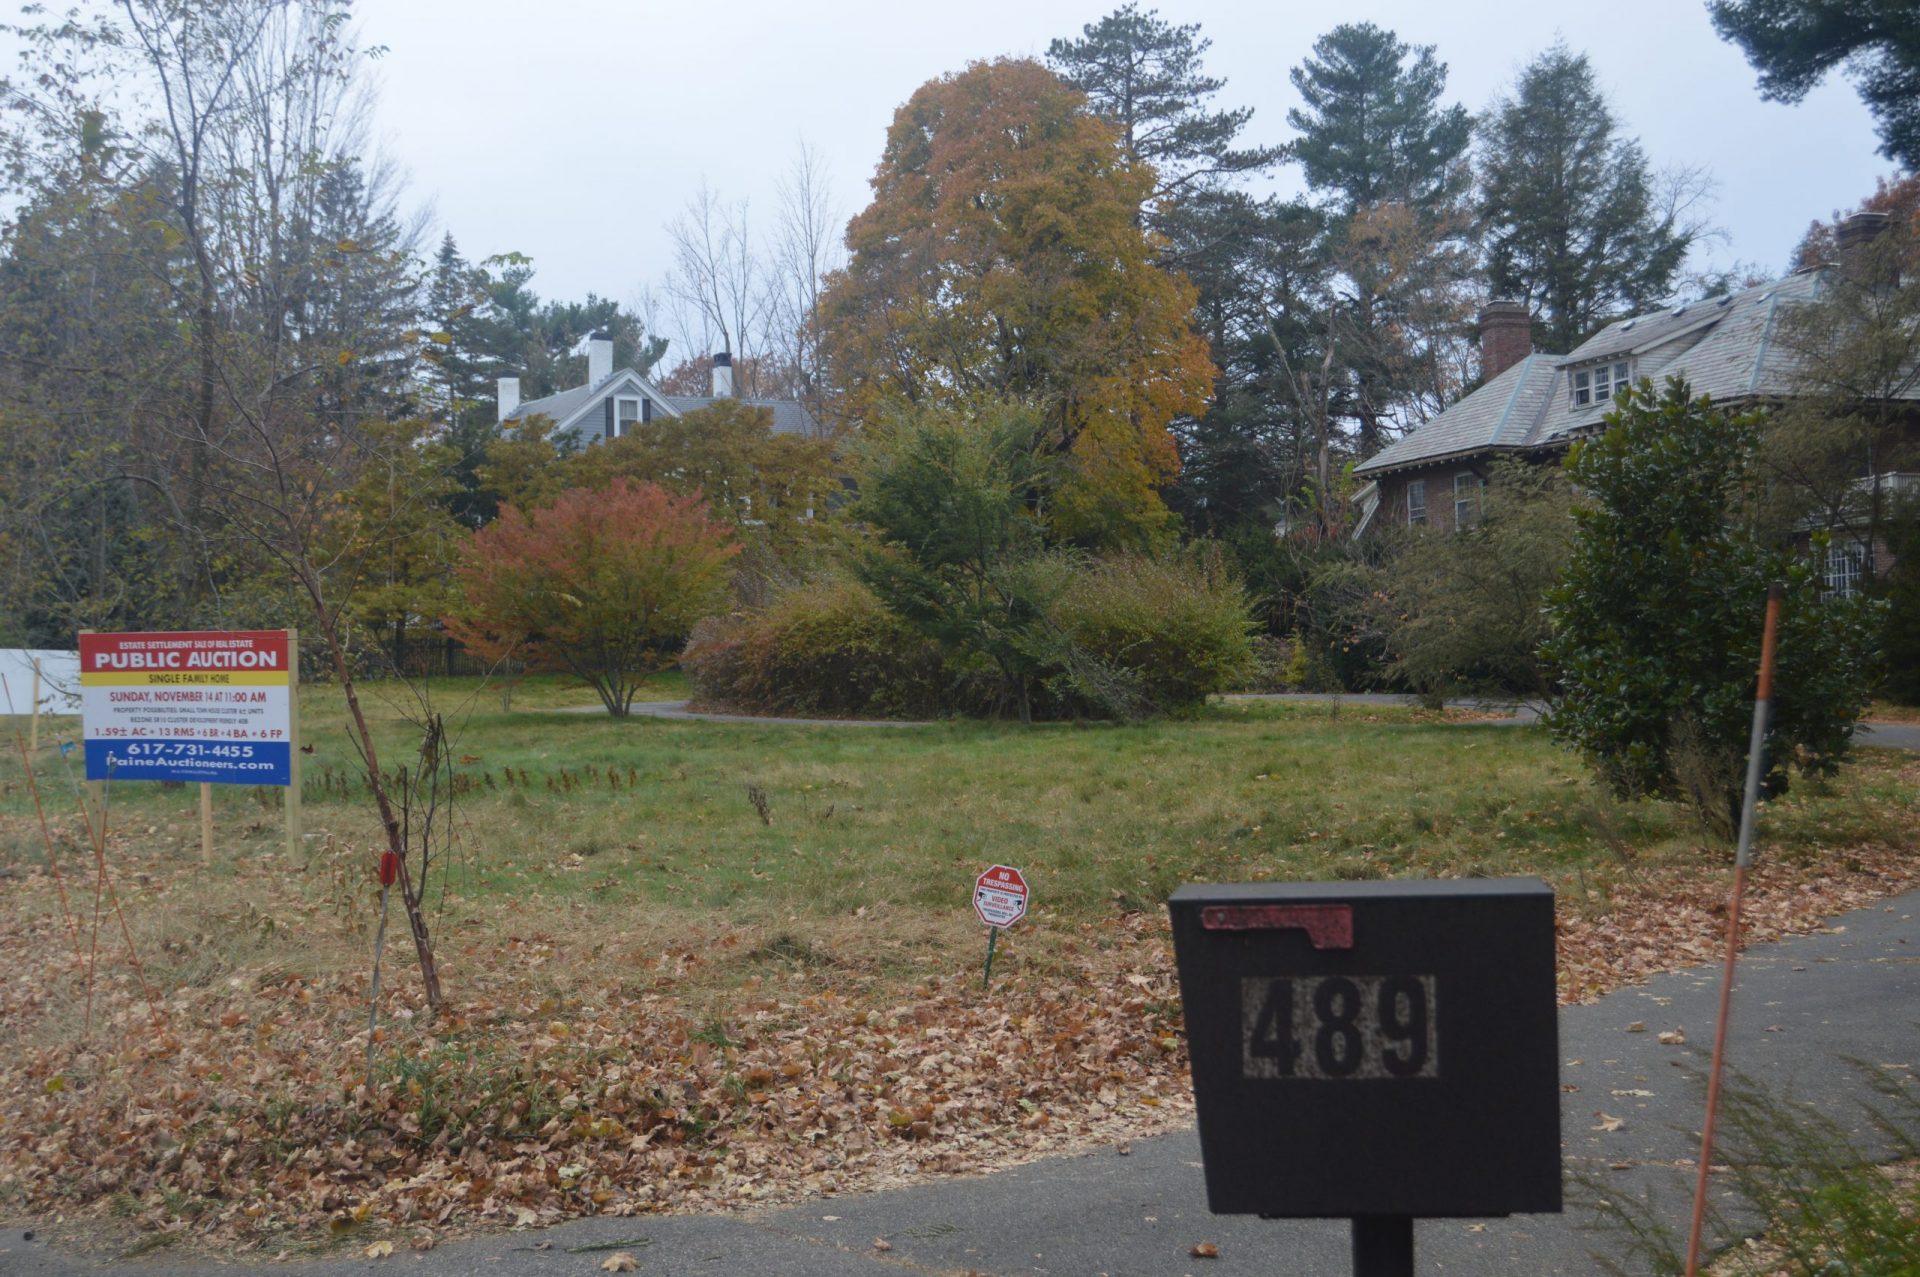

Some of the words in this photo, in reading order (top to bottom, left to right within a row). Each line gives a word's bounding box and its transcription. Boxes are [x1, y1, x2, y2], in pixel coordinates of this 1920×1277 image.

[119, 641, 146, 650] ESTATE
[147, 641, 193, 649] SETTLEMENT
[194, 640, 207, 649] SALE
[207, 640, 215, 648] OF
[215, 640, 228, 648] REAL
[228, 640, 254, 648] ESTATE
[95, 652, 181, 669] PUBLIC
[187, 651, 277, 668] AUCTION
[149, 674, 181, 683] SINGLE
[183, 674, 209, 683] FAMILY
[210, 674, 230, 683] HOME
[110, 691, 152, 703] SUNDAY,
[154, 691, 203, 702] NOVEMBER
[205, 692, 213, 702] 14
[214, 692, 223, 702] AT
[225, 692, 248, 703] 11:00
[250, 692, 267, 703] AM
[132, 727, 147, 737] AC
[159, 728, 170, 737] 13
[174, 728, 195, 737] RMS
[202, 729, 208, 737] 6
[209, 729, 219, 737] BR
[226, 729, 231, 737] 4
[233, 729, 248, 738] BA
[260, 729, 267, 738] 6
[270, 729, 283, 738] FP
[127, 743, 255, 758] 617-731-4455
[106, 756, 275, 770] PaineAuctioneers.com
[998, 871, 1010, 881] NO
[983, 877, 1024, 892] TRESPASSING
[991, 895, 1009, 904] VIDEO
[1248, 975, 1430, 1078] 489
